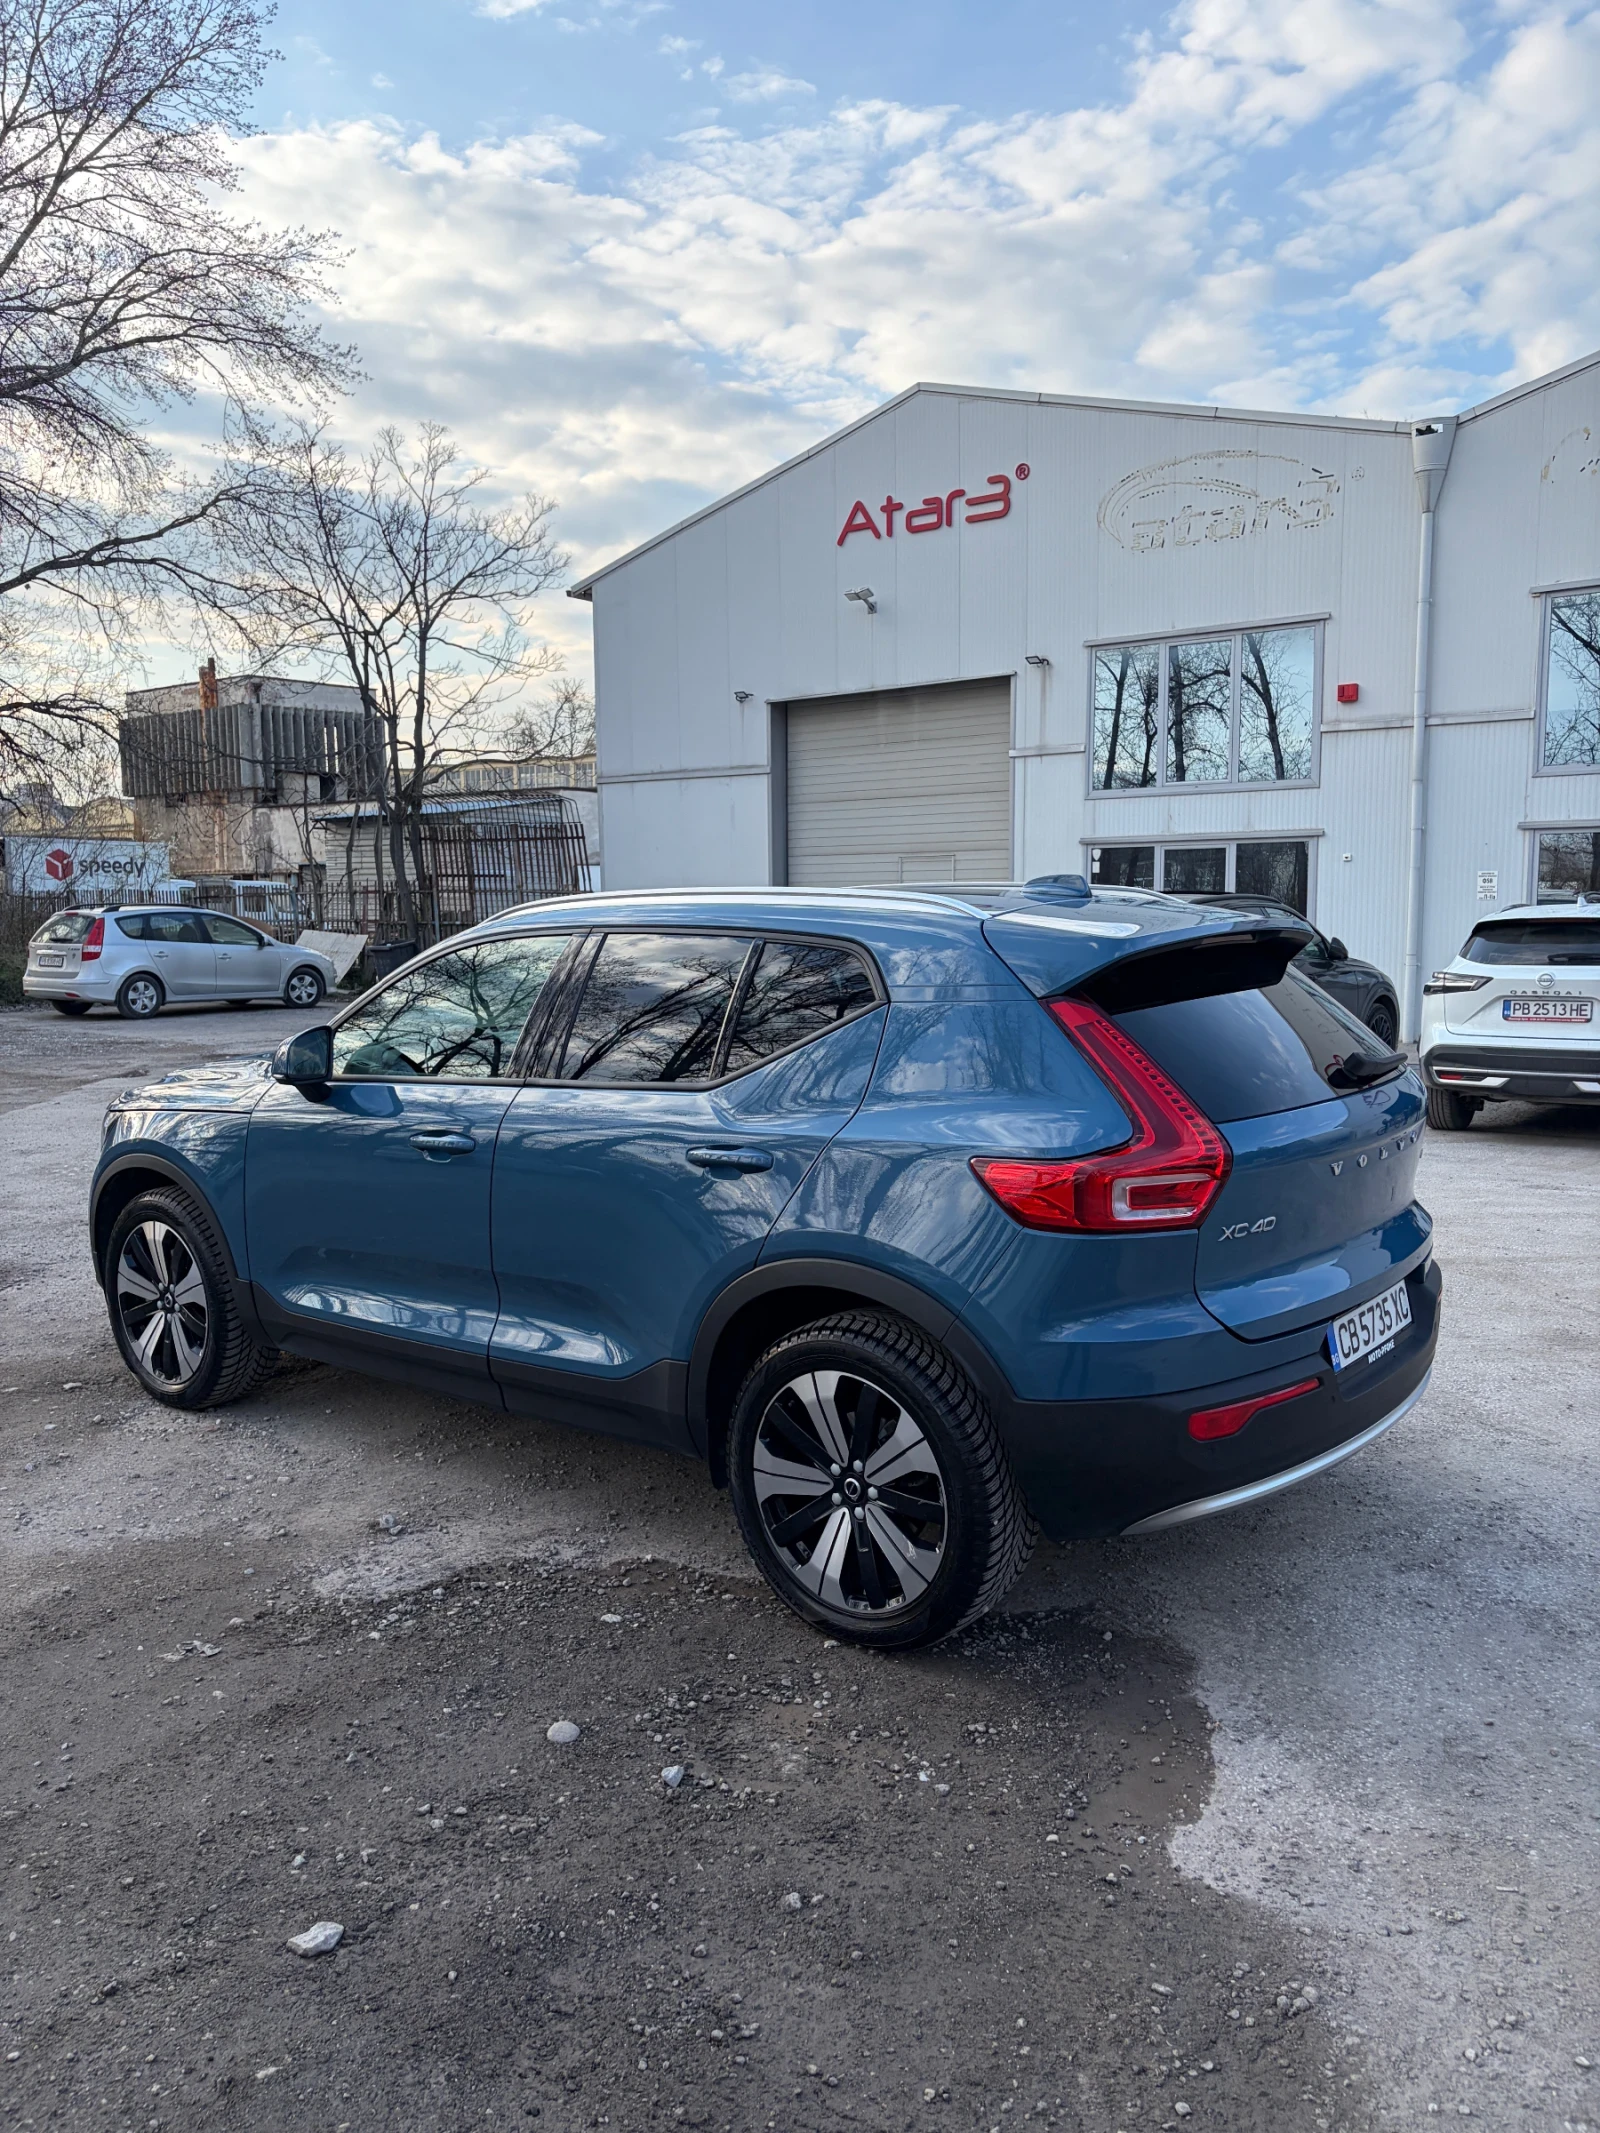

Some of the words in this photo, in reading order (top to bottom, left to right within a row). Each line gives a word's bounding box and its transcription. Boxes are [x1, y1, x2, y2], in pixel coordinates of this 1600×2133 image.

[79, 856, 146, 878] speedy
[1513, 1002, 1531, 1015] PB
[1533, 1003, 1567, 1016] 2513
[1570, 1003, 1589, 1017] HE
[1330, 1130, 1418, 1176] VOLVO
[1217, 1216, 1277, 1242] XC40
[1338, 1327, 1360, 1358] CB
[1358, 1296, 1392, 1347] 5735
[1390, 1286, 1409, 1326] XC
